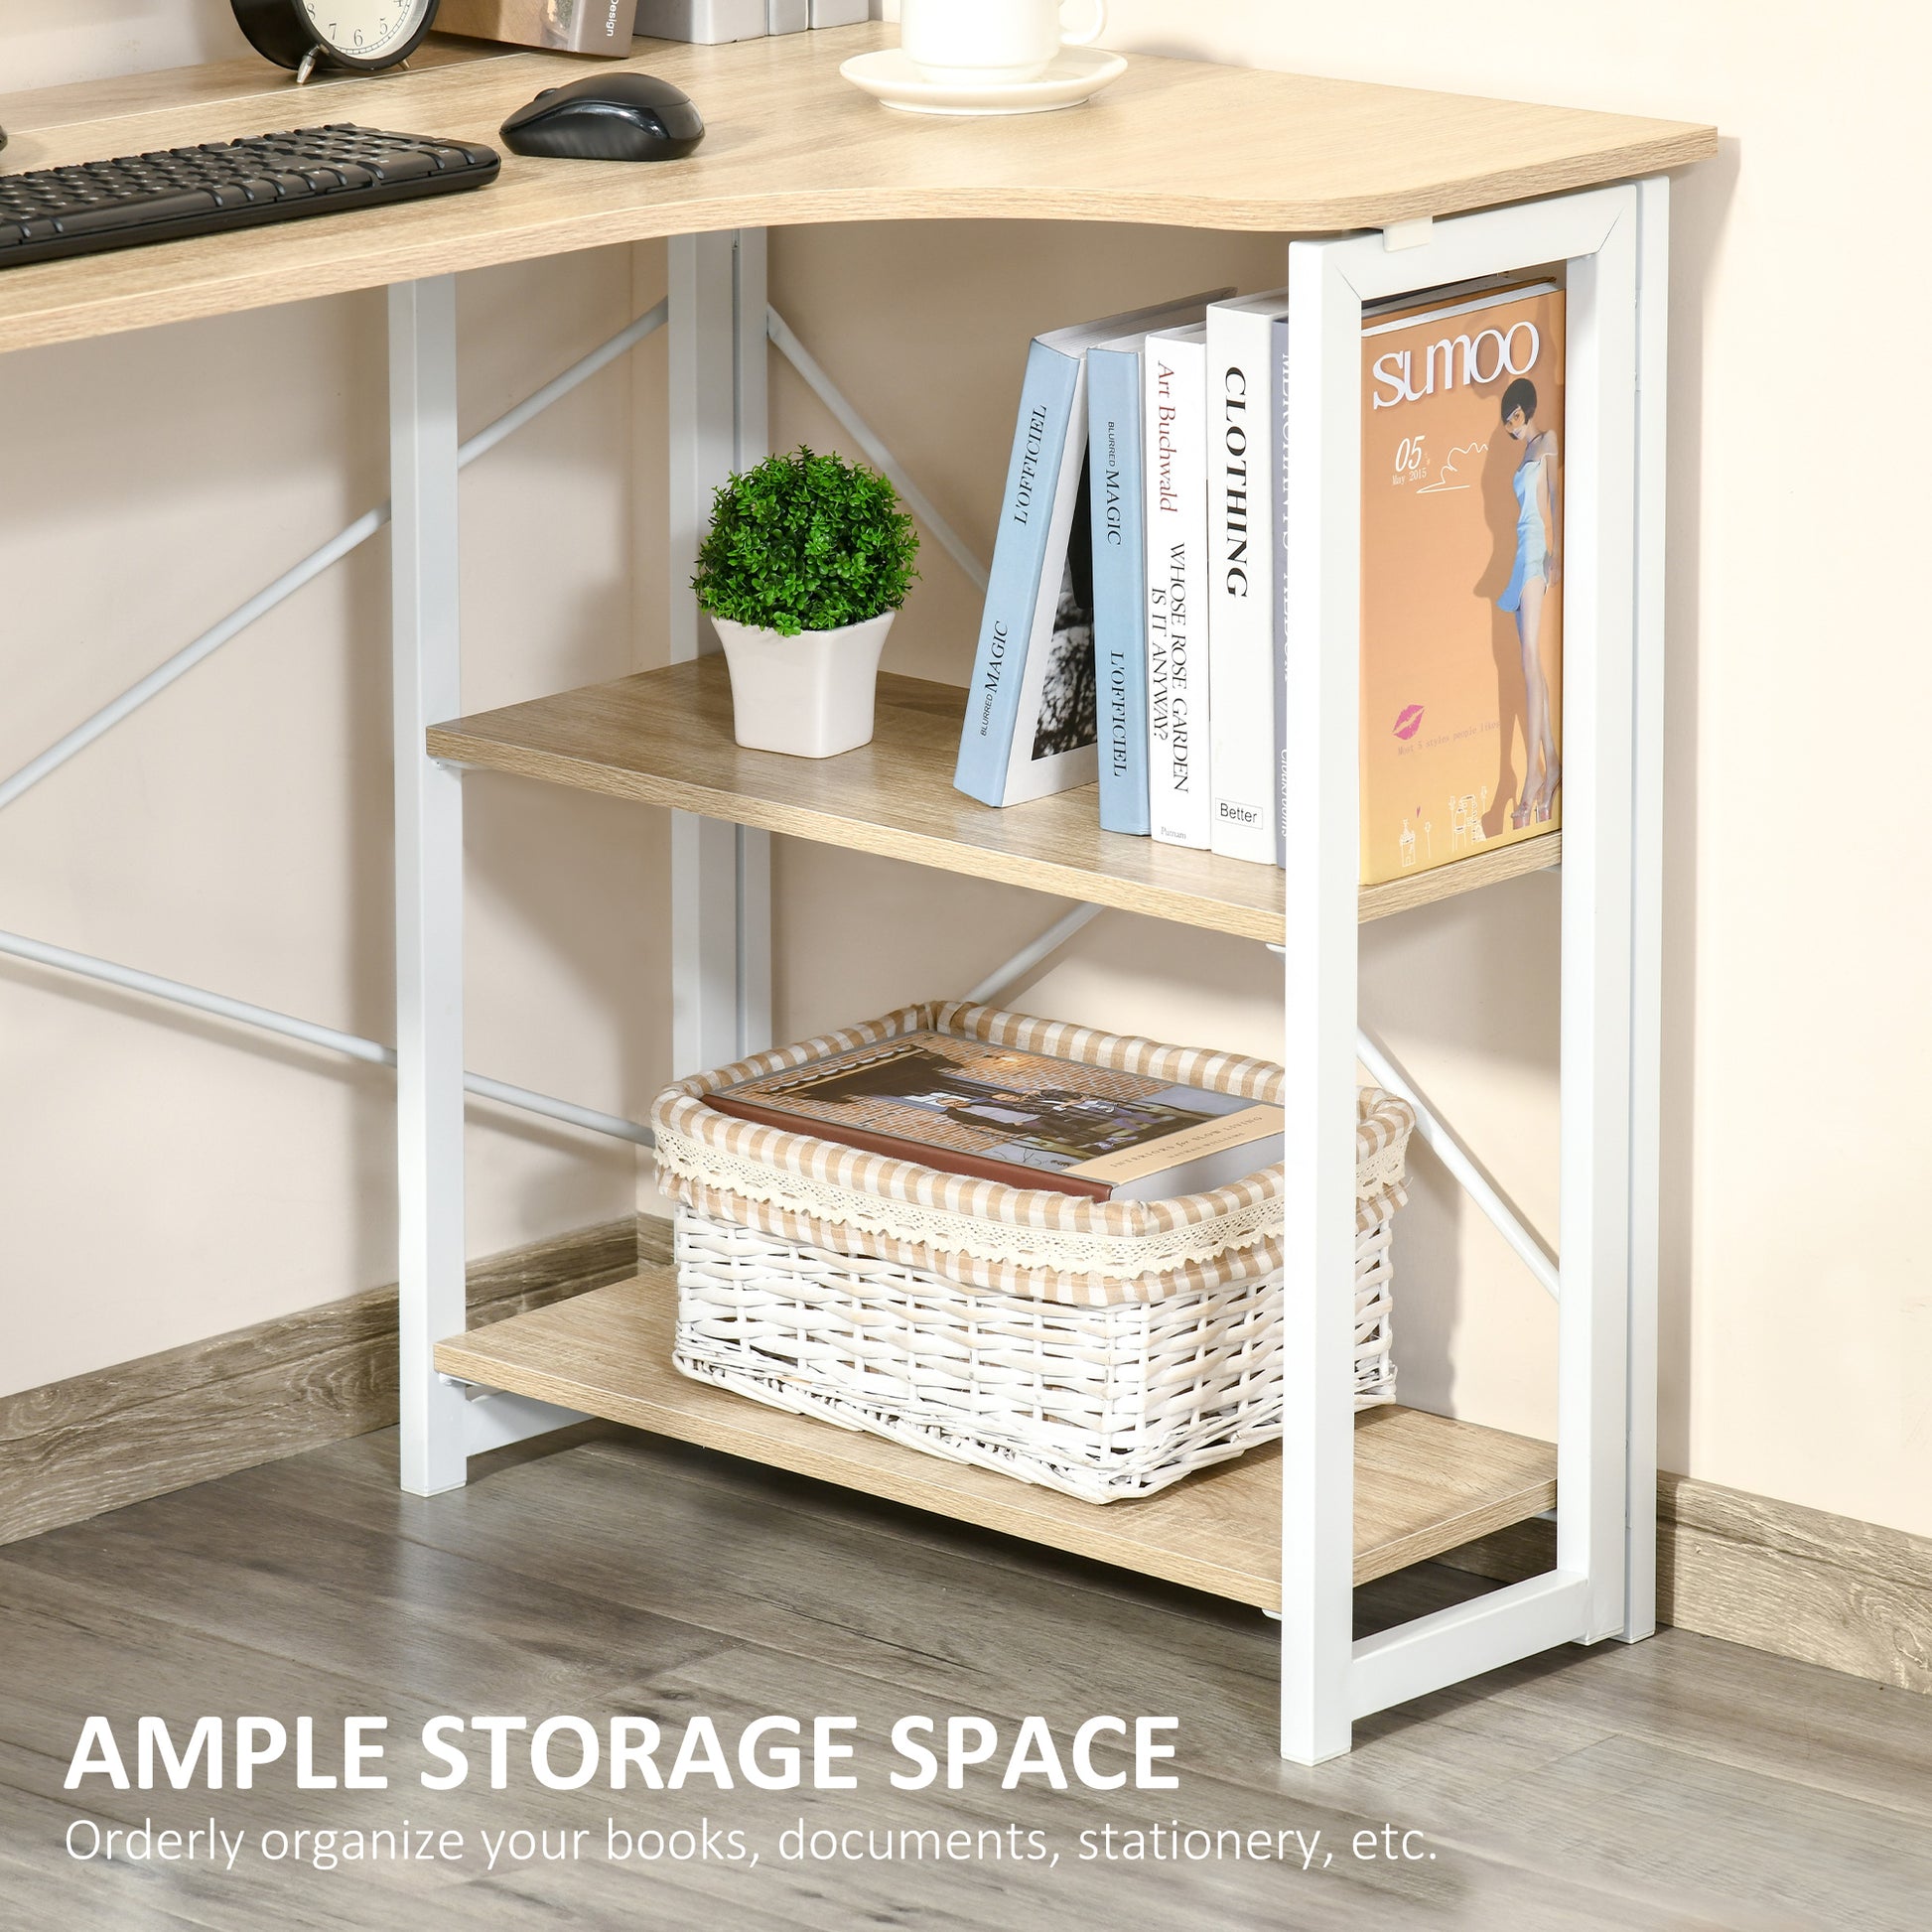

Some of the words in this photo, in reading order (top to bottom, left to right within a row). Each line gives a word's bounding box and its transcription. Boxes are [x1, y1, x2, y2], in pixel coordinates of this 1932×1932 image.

[329, 23, 338, 41] 7
[353, 29, 363, 47] 6
[379, 17, 388, 35] 5
[1158, 360, 1175, 398] Art
[1014, 405, 1047, 526] L'OFFICIEL
[1107, 421, 1116, 467] BLURRED
[1159, 406, 1178, 513] Buchwald
[1395, 435, 1426, 473] 05
[1225, 366, 1248, 598] CLOTHING
[1106, 469, 1122, 546] MAGIC
[1152, 588, 1168, 606] IS
[1171, 542, 1187, 626] WHOSE
[1152, 614, 1168, 637] IT
[985, 621, 1009, 693] MAGIC
[1172, 633, 1187, 690] ROSE
[1110, 650, 1128, 777] L'OFFICIEL
[1152, 642, 1169, 742] ANYWAY?
[980, 694, 994, 737] BLURRED
[1173, 698, 1189, 794] GARDEN
[1161, 826, 1187, 840] Putnam
[1220, 802, 1258, 823] Better
